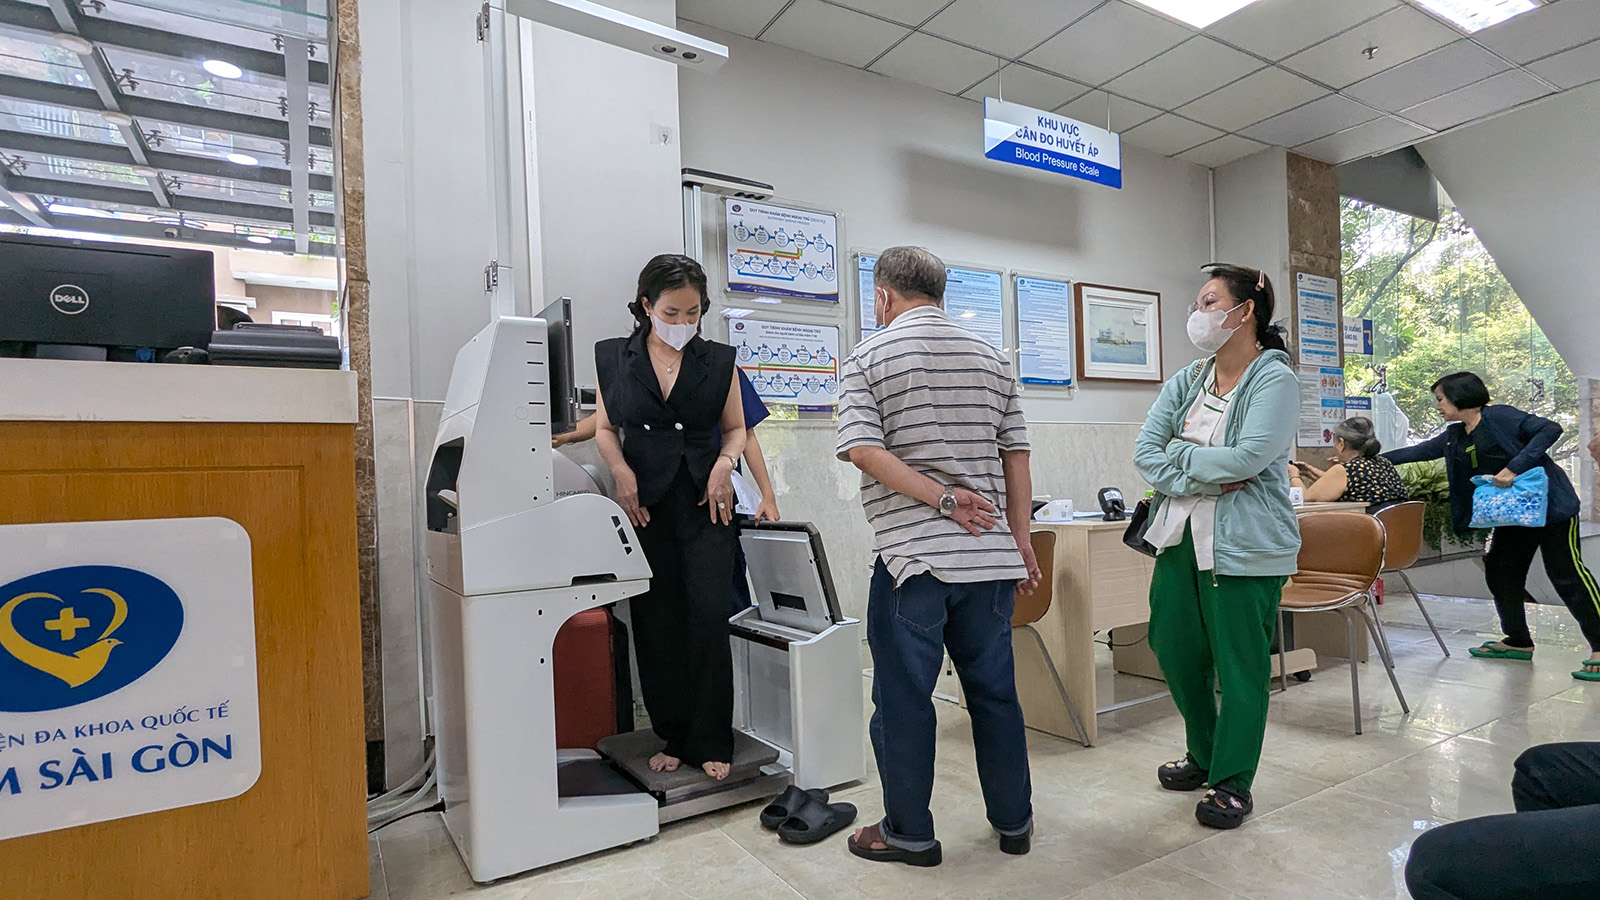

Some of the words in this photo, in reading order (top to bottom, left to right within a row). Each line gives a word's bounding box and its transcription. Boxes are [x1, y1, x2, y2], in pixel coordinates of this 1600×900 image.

[1015, 126, 1037, 142] CÂN
[1039, 132, 1054, 145] ĐO
[1056, 136, 1085, 154] HUYẾT
[1087, 143, 1099, 157] ÁP
[1037, 116, 1058, 131] KHU
[1060, 123, 1080, 138] VỰC
[1015, 147, 1040, 163] Blood
[1042, 153, 1078, 171] Pressure
[1079, 162, 1100, 177] Scale
[55, 294, 85, 304] DELL
[34, 728, 67, 744] ĐA
[74, 719, 135, 739] KHOA
[141, 705, 200, 730] QUỐC
[206, 700, 230, 720] TẾ
[39, 748, 113, 790] SÀI
[130, 733, 233, 773] GÒN
